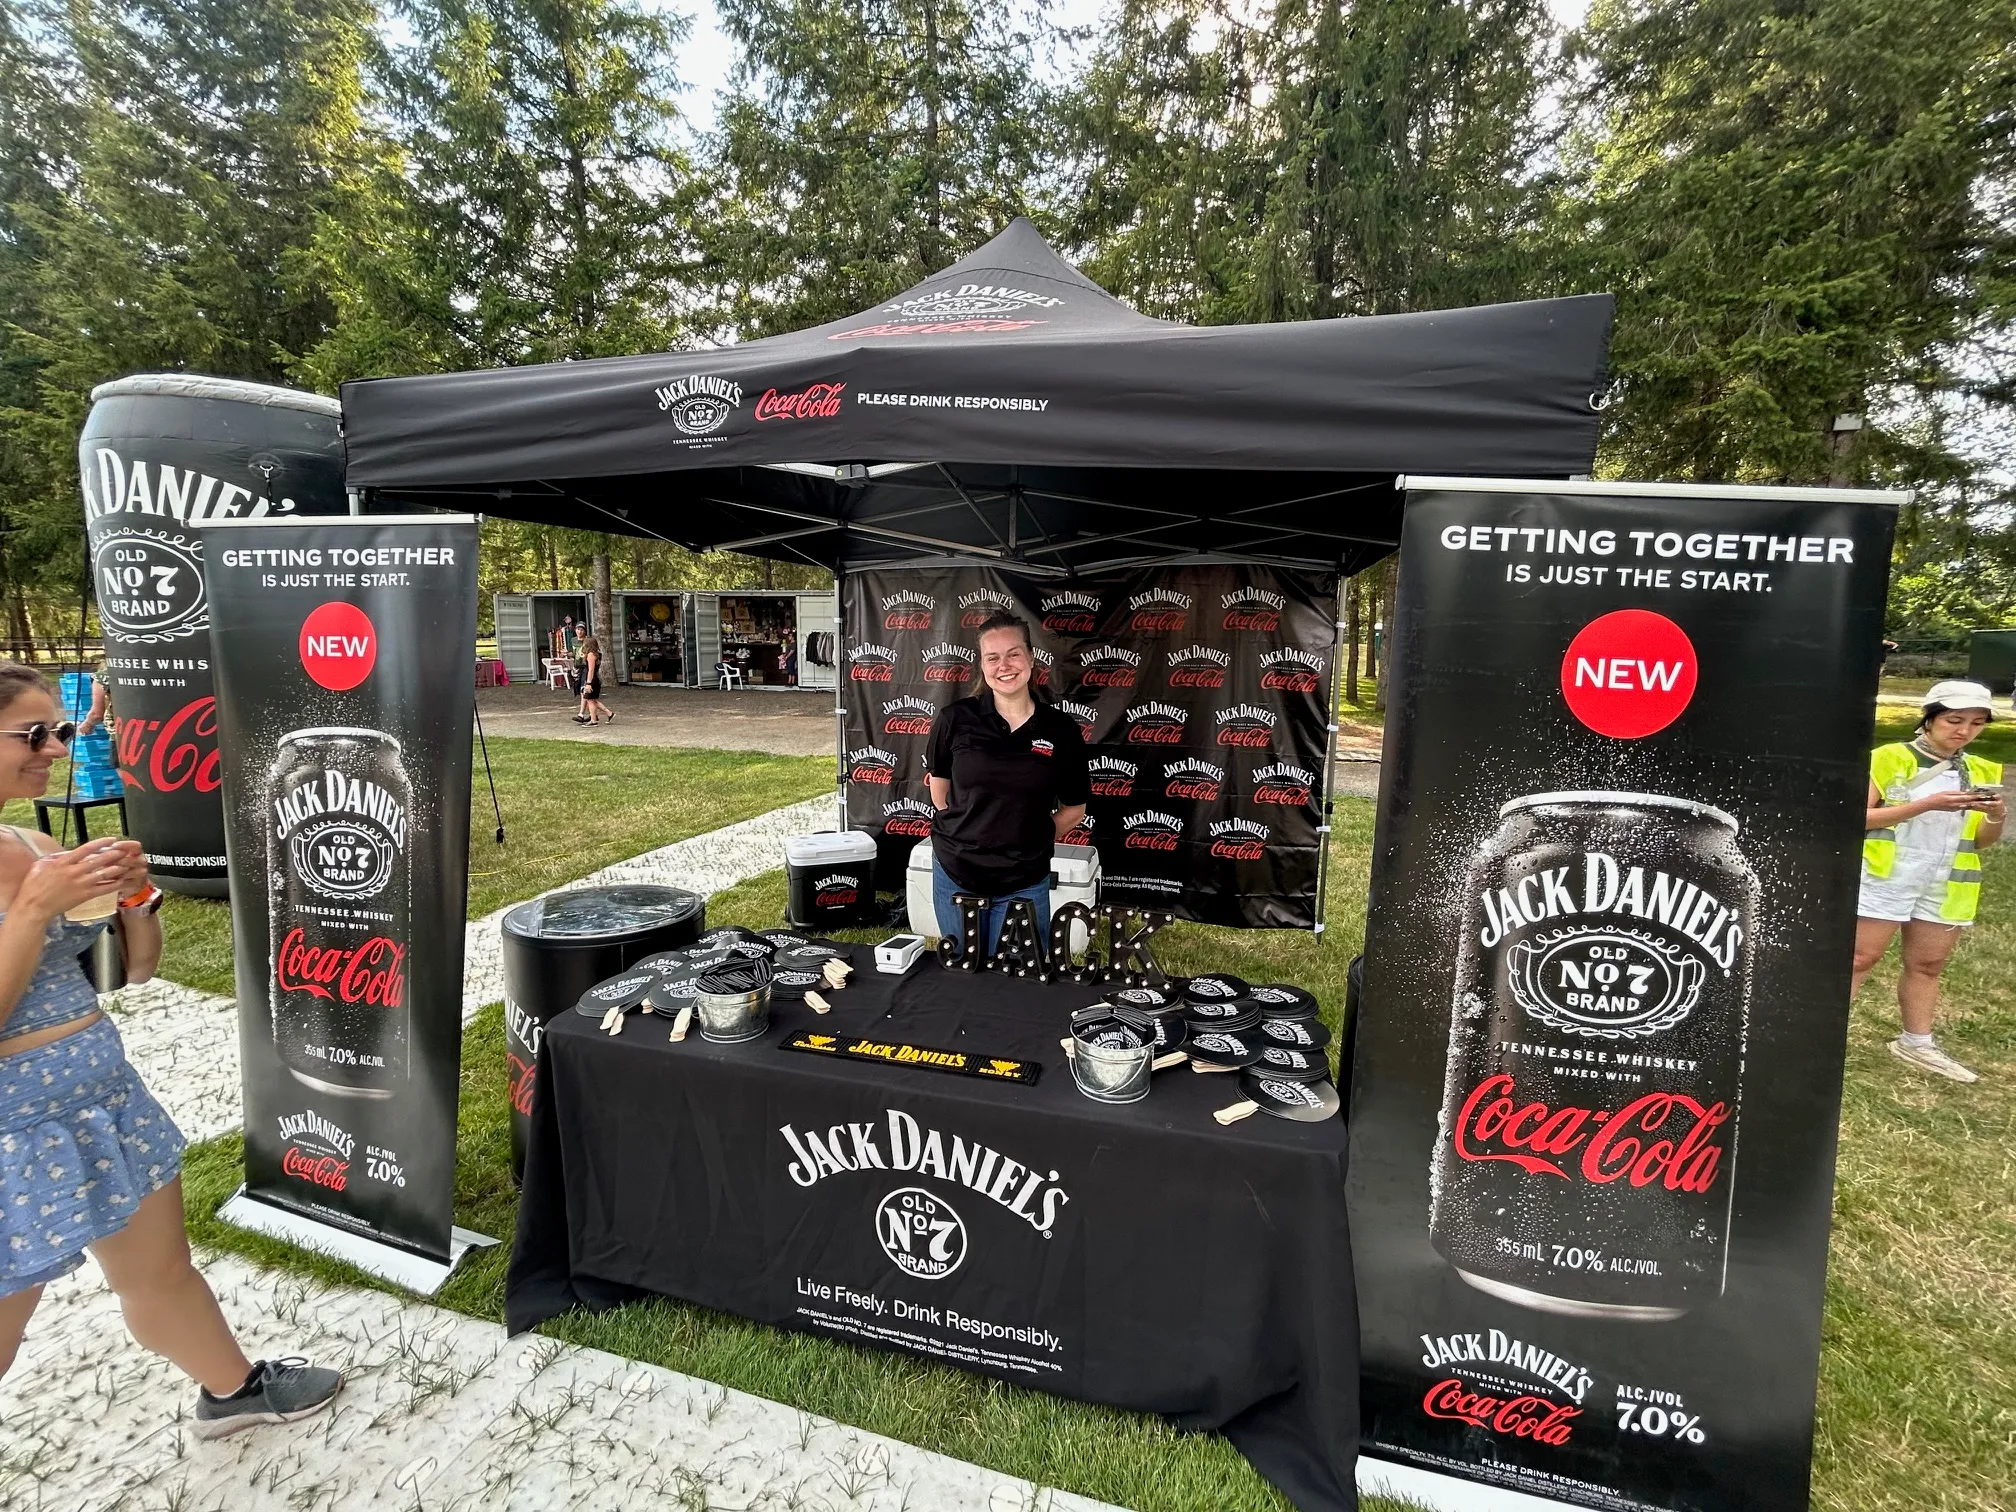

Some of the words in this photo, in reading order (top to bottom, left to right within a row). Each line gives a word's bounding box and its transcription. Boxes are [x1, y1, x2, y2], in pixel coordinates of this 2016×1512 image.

[882, 290, 952, 312] JACK
[955, 284, 1066, 307] DANIEL'S
[655, 378, 687, 410] JACK
[689, 375, 743, 405] DANIEL'S
[754, 382, 847, 421] Coca-Cola
[858, 393, 907, 406] PLEASE
[910, 395, 951, 407] DRINK
[954, 396, 1048, 412] RESPONSIBLY
[96, 448, 300, 518] DANIE'
[1440, 525, 1616, 556] GETTING
[1628, 531, 1854, 564] TOGETHER
[116, 550, 147, 562] OLD
[222, 549, 322, 567] GETTING
[328, 547, 454, 566] TOGETHER
[262, 574, 277, 587] IS
[280, 573, 319, 587] JUST
[323, 573, 355, 587] THE
[360, 572, 410, 587] START.
[1506, 564, 1531, 583] IS
[1538, 565, 1608, 585] JUST
[1616, 568, 1670, 588] THE
[1680, 570, 1772, 593] START.
[111, 600, 170, 617] BRAND
[882, 595, 902, 611] JACK
[902, 589, 936, 611] DANIEL'S
[1129, 591, 1152, 610] JACK
[1153, 587, 1192, 610] DANIEL'S
[1221, 589, 1245, 609] JACK
[1247, 586, 1286, 610] DANIEL'S
[885, 611, 931, 630] Coca-Cola
[1131, 611, 1188, 631] Coca-Cola
[1222, 611, 1282, 632] Coca-Cola
[307, 635, 369, 657] NEW
[848, 644, 864, 662] JACK
[864, 642, 898, 663] DANIEL'S
[921, 645, 941, 662] JACK
[942, 642, 976, 663] DANIEL'S
[1167, 648, 1191, 667] JACK
[1192, 644, 1231, 667] DANIEL'S
[106, 658, 150, 669] NESSEE
[156, 659, 208, 670] WHIS
[1260, 650, 1284, 668] JACK
[1284, 647, 1326, 672] DANIEL'S
[118, 678, 146, 686] MIXED
[150, 679, 186, 687] WITH
[850, 665, 893, 682] Coca-Cola
[924, 665, 972, 683] Coca-Cola
[1169, 668, 1227, 688] Coca-Cola
[1260, 671, 1321, 692] Coca-Cola
[1574, 657, 1683, 692] NEW
[1062, 700, 1098, 722] DANIEL'S
[1126, 704, 1150, 723] JACK
[1151, 701, 1188, 724] DANIEL'S
[1128, 724, 1185, 743] Coca-Cola
[850, 748, 868, 764] JACK
[868, 745, 898, 768] DANIEL'S
[852, 766, 895, 785] Coca-Cola
[1163, 761, 1187, 778] JACK
[1188, 757, 1225, 782] DANIEL'S
[1165, 780, 1221, 801] Coca-Cola
[275, 780, 325, 840] JACK
[325, 769, 406, 849] DANIEL'S
[1123, 814, 1146, 829] JACK
[1147, 810, 1184, 832] DANIEL'S
[332, 835, 356, 845] OLD
[1125, 831, 1180, 851] Coca-Cola
[152, 855, 174, 866] DRINK
[174, 856, 227, 867] RESPONSIB
[323, 868, 365, 881] BRAND
[815, 878, 832, 891] JACK
[832, 874, 859, 888] DANIEL'S
[816, 889, 858, 906] Coca-Cola
[294, 904, 349, 917] TENNESSEE
[353, 906, 394, 922] WHISKEY
[1480, 866, 1578, 948] JACK
[1582, 852, 1744, 969] DANIEL'S
[321, 920, 345, 928] MIXED
[348, 922, 369, 931] WITH
[739, 941, 772, 954] DANIEL'S
[936, 892, 1175, 989] JACK
[1589, 946, 1627, 961] OLD
[278, 928, 405, 1008] Coca-Cola
[690, 959, 713, 970] JACK
[591, 983, 616, 997] JACK
[662, 979, 688, 991] JACK
[1566, 992, 1640, 1012] BRAND
[505, 990, 544, 1054] NIEL'S
[329, 1047, 356, 1065] 7.0%
[848, 1040, 897, 1058] JACK
[896, 1045, 966, 1067] DANIEL'S
[1501, 1041, 1608, 1063] TENNESSEE
[1616, 1053, 1697, 1071] WHISKEY
[978, 1067, 1021, 1078] HONEY
[1553, 1067, 1598, 1079] MIXED
[1605, 1072, 1641, 1082] WITH
[278, 1112, 308, 1140] JACK
[307, 1109, 355, 1158] DANIEL'S
[1454, 1073, 1733, 1194] Coca-Cola
[282, 1147, 350, 1192] Coca-Cola
[366, 1157, 406, 1188] 7.0%
[780, 1123, 888, 1187] JACK
[886, 1109, 1070, 1231] DANIEL'S
[902, 1194, 936, 1215] OLD
[898, 1252, 948, 1274] BRAND
[1551, 1245, 1604, 1271] 7.0%
[797, 1276, 831, 1300] Live
[835, 1285, 888, 1316] Freely.
[894, 1299, 941, 1326] Drink
[946, 1310, 1063, 1353] Responsibly.
[1420, 1333, 1488, 1368] JACK
[1488, 1328, 1594, 1400] DANIEL'S
[1451, 1367, 1506, 1385] TENNESSEE
[1509, 1379, 1554, 1395] WHISKEY
[1479, 1382, 1501, 1392] MIXED
[1504, 1387, 1522, 1396] WITH
[1423, 1379, 1584, 1446] Coca-Cola
[1616, 1401, 1705, 1444] 7.0%
[1481, 1458, 1518, 1473] PLEASE
[1520, 1466, 1550, 1480] DRINK
[1552, 1474, 1620, 1497] RESPONSIBLY.
